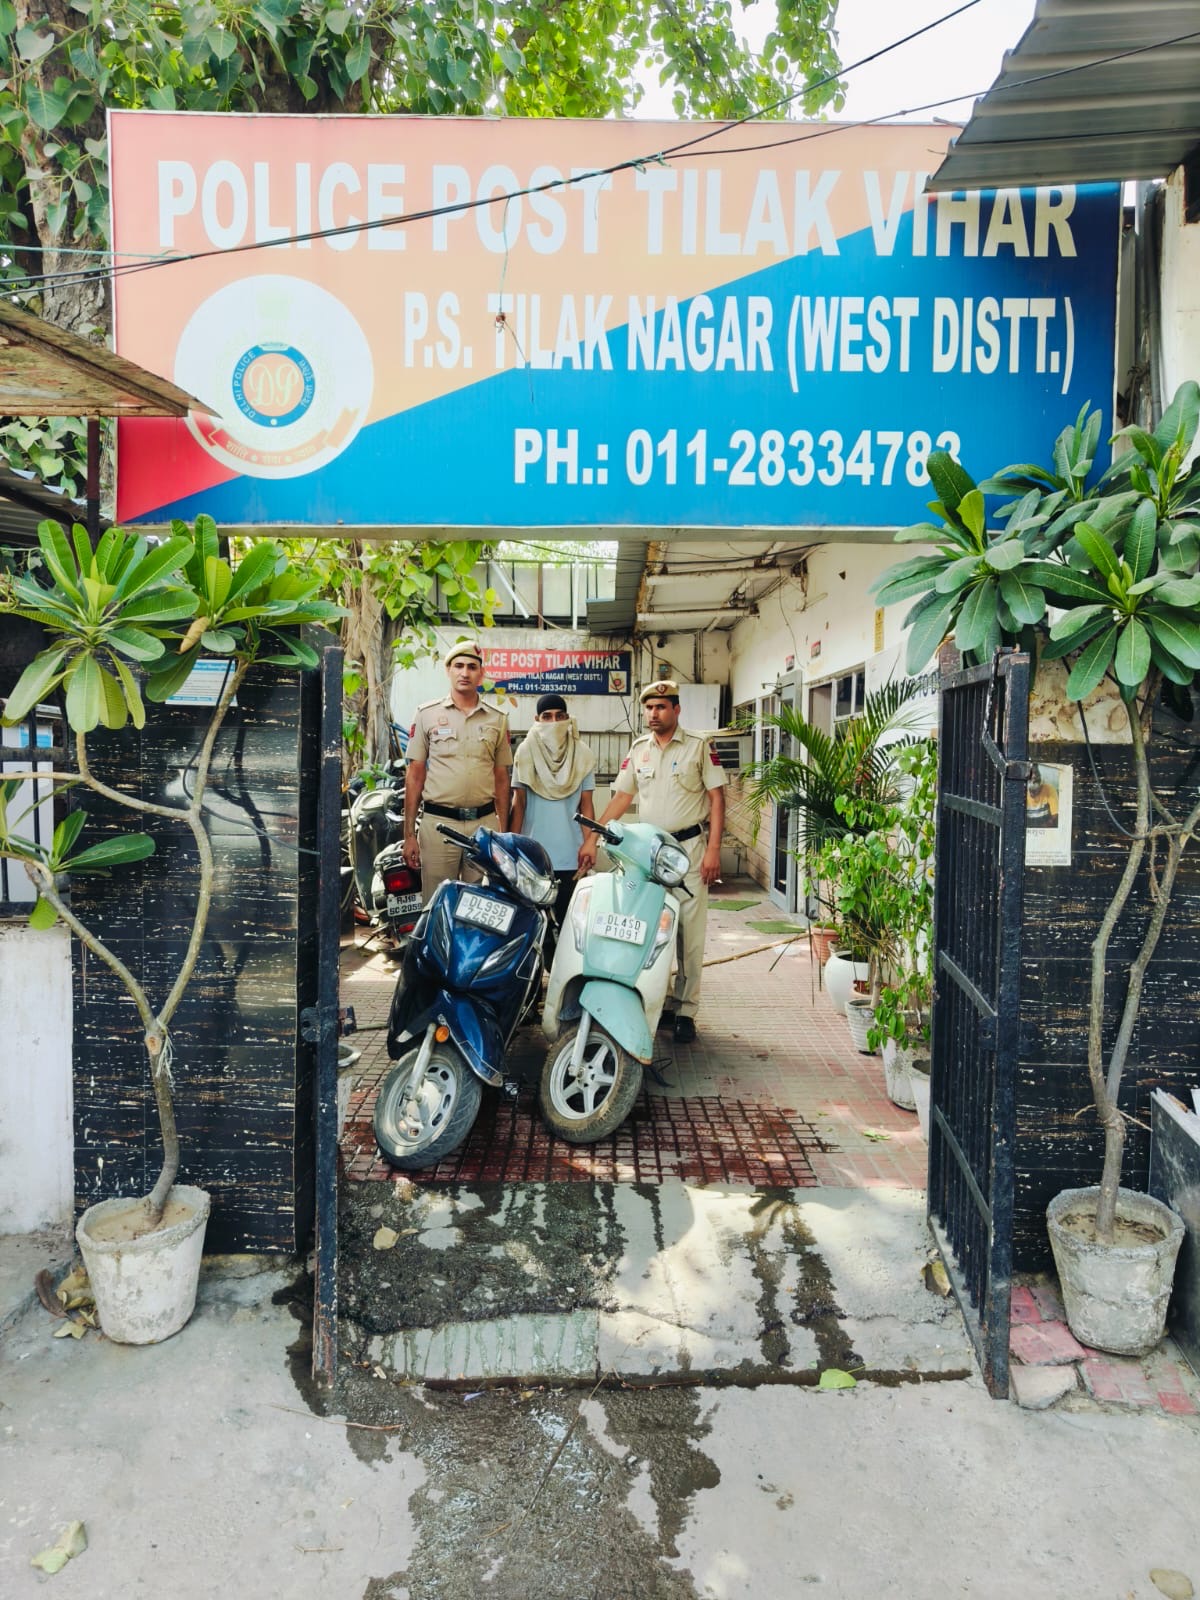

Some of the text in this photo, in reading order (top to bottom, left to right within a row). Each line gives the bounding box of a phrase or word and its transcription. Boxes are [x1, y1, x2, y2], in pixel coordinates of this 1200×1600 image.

[157, 160, 1077, 257] POLICE POST TILAK VIHAR
[404, 292, 1075, 395] P.S. TILAK NAGAR (WEST DISTT.)
[233, 350, 256, 418] DELHI POLICE
[513, 428, 962, 487] PH.: 011-28334783
[510, 653, 542, 669] POST
[544, 653, 581, 669] TILAK
[583, 654, 621, 670] VIHAR
[469, 896, 508, 918] DL9SB
